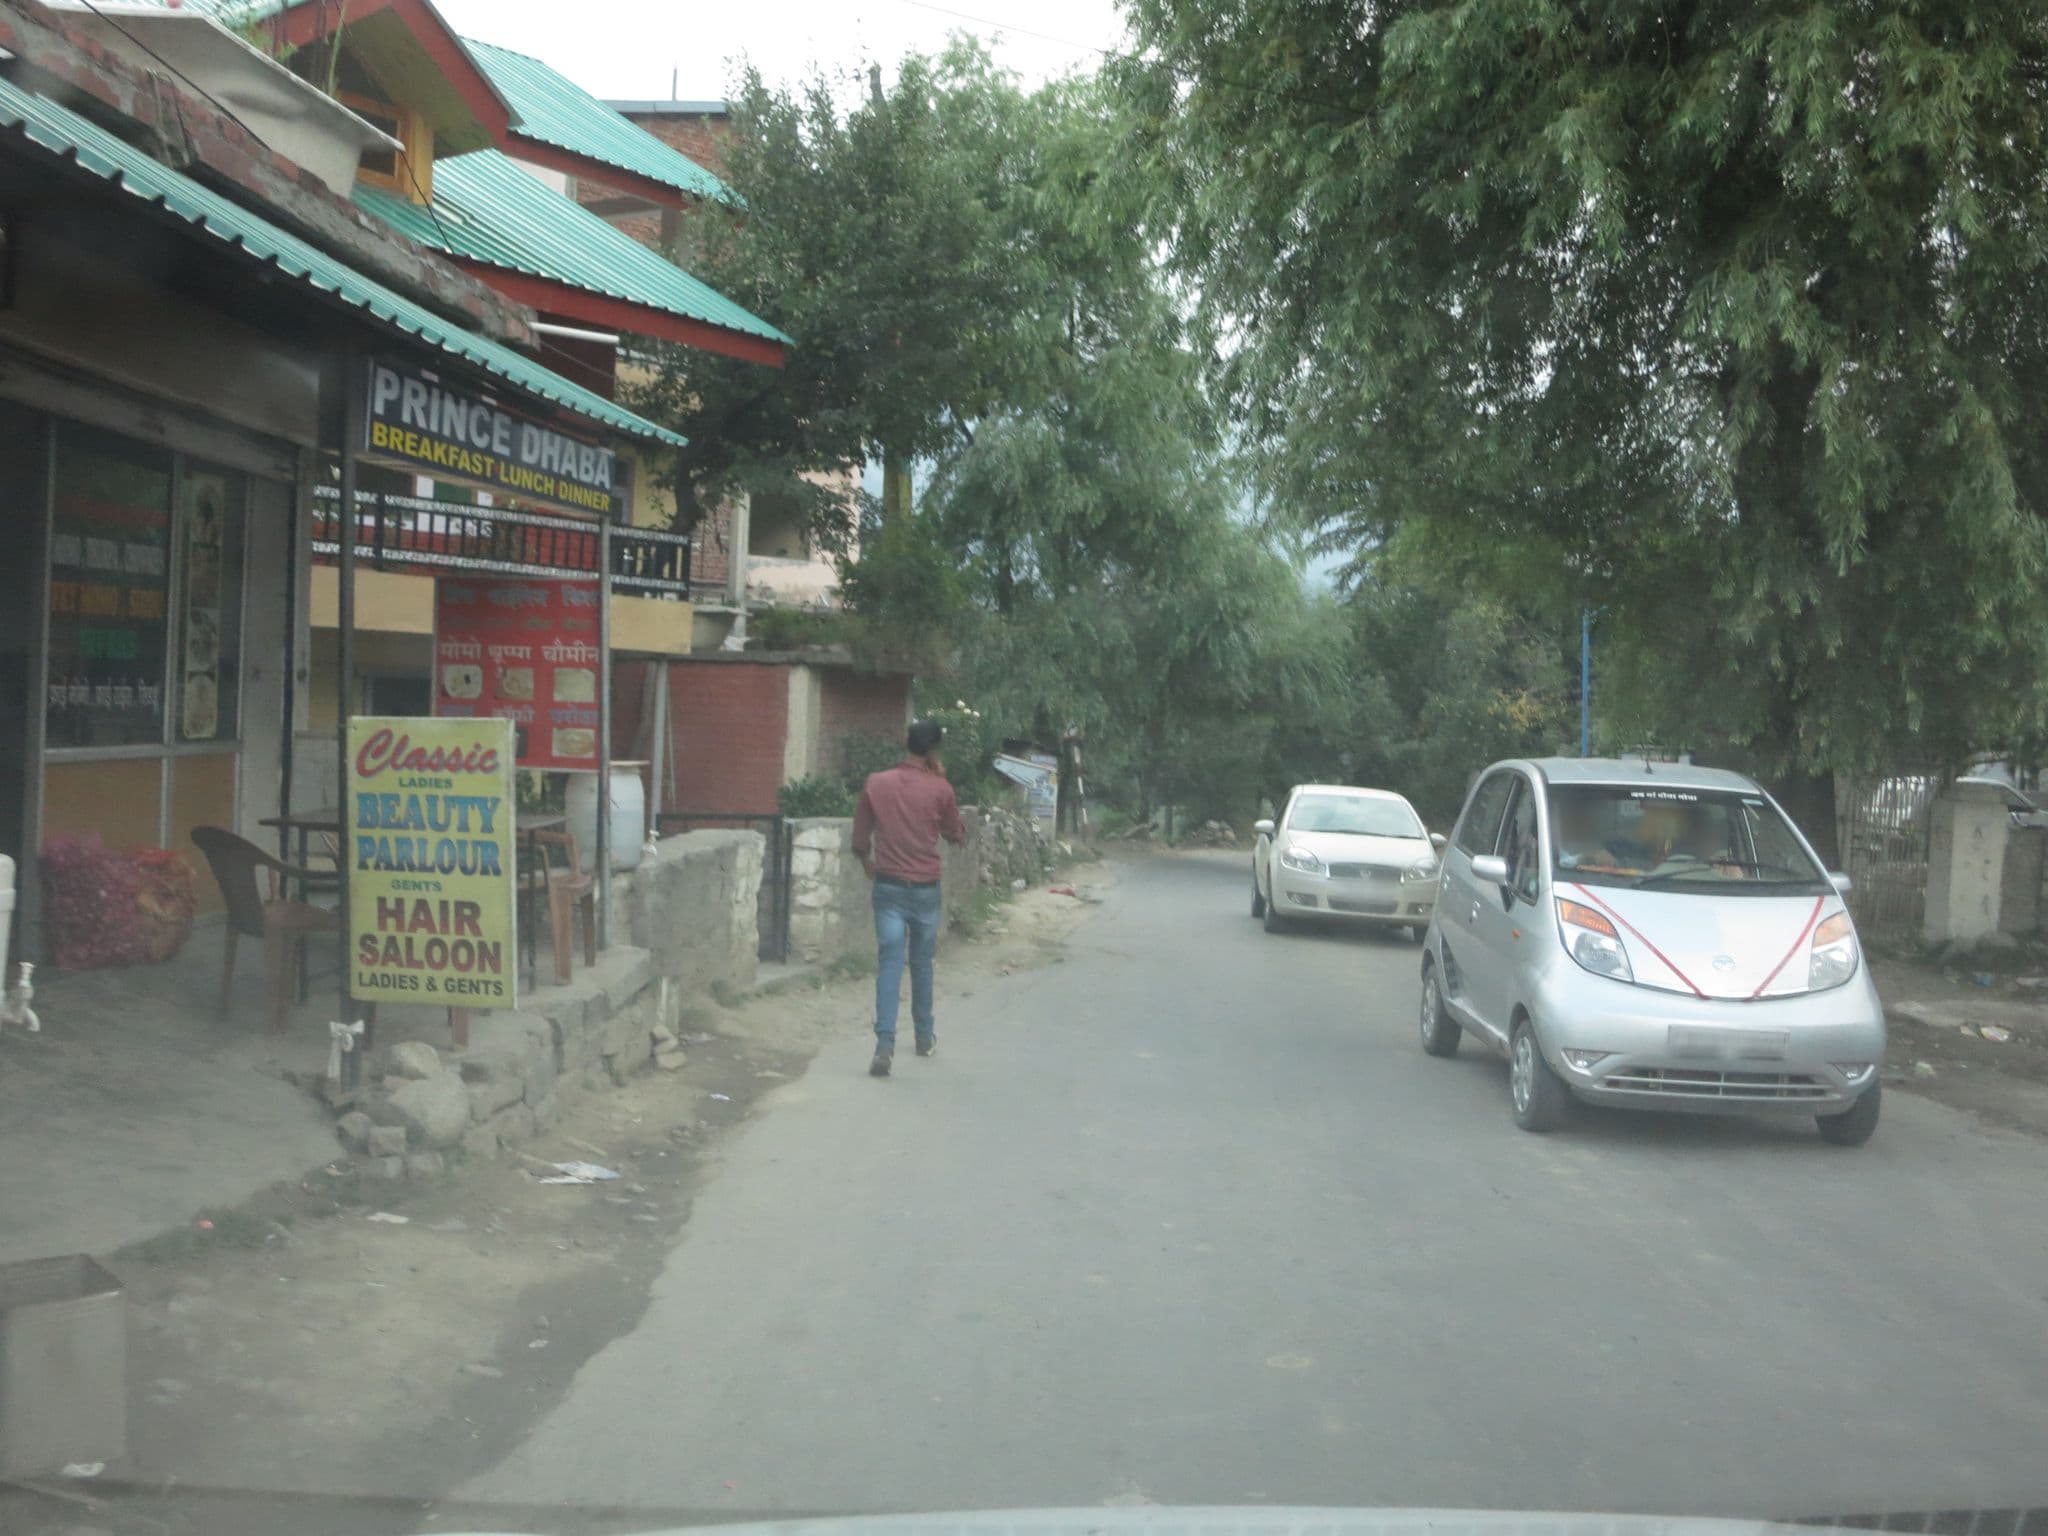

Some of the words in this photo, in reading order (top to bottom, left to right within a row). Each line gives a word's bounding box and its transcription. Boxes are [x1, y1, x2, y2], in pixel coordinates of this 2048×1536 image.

[373, 367, 511, 456] PRINCE
[521, 424, 612, 490] DHABA
[372, 422, 495, 478] BREAKFAST
[499, 462, 554, 497] LUNCH
[558, 482, 610, 512] DINNER
[356, 728, 499, 778] Classic
[398, 777, 453, 789] LADIES
[356, 792, 501, 834] BEAUTY
[356, 835, 502, 877] PARLOUR
[391, 879, 442, 892] GENTS
[376, 896, 482, 937] HAIR
[358, 933, 502, 974] SALOON
[358, 972, 420, 991] LADIES
[426, 976, 438, 992] &
[444, 977, 503, 996] GENTS
